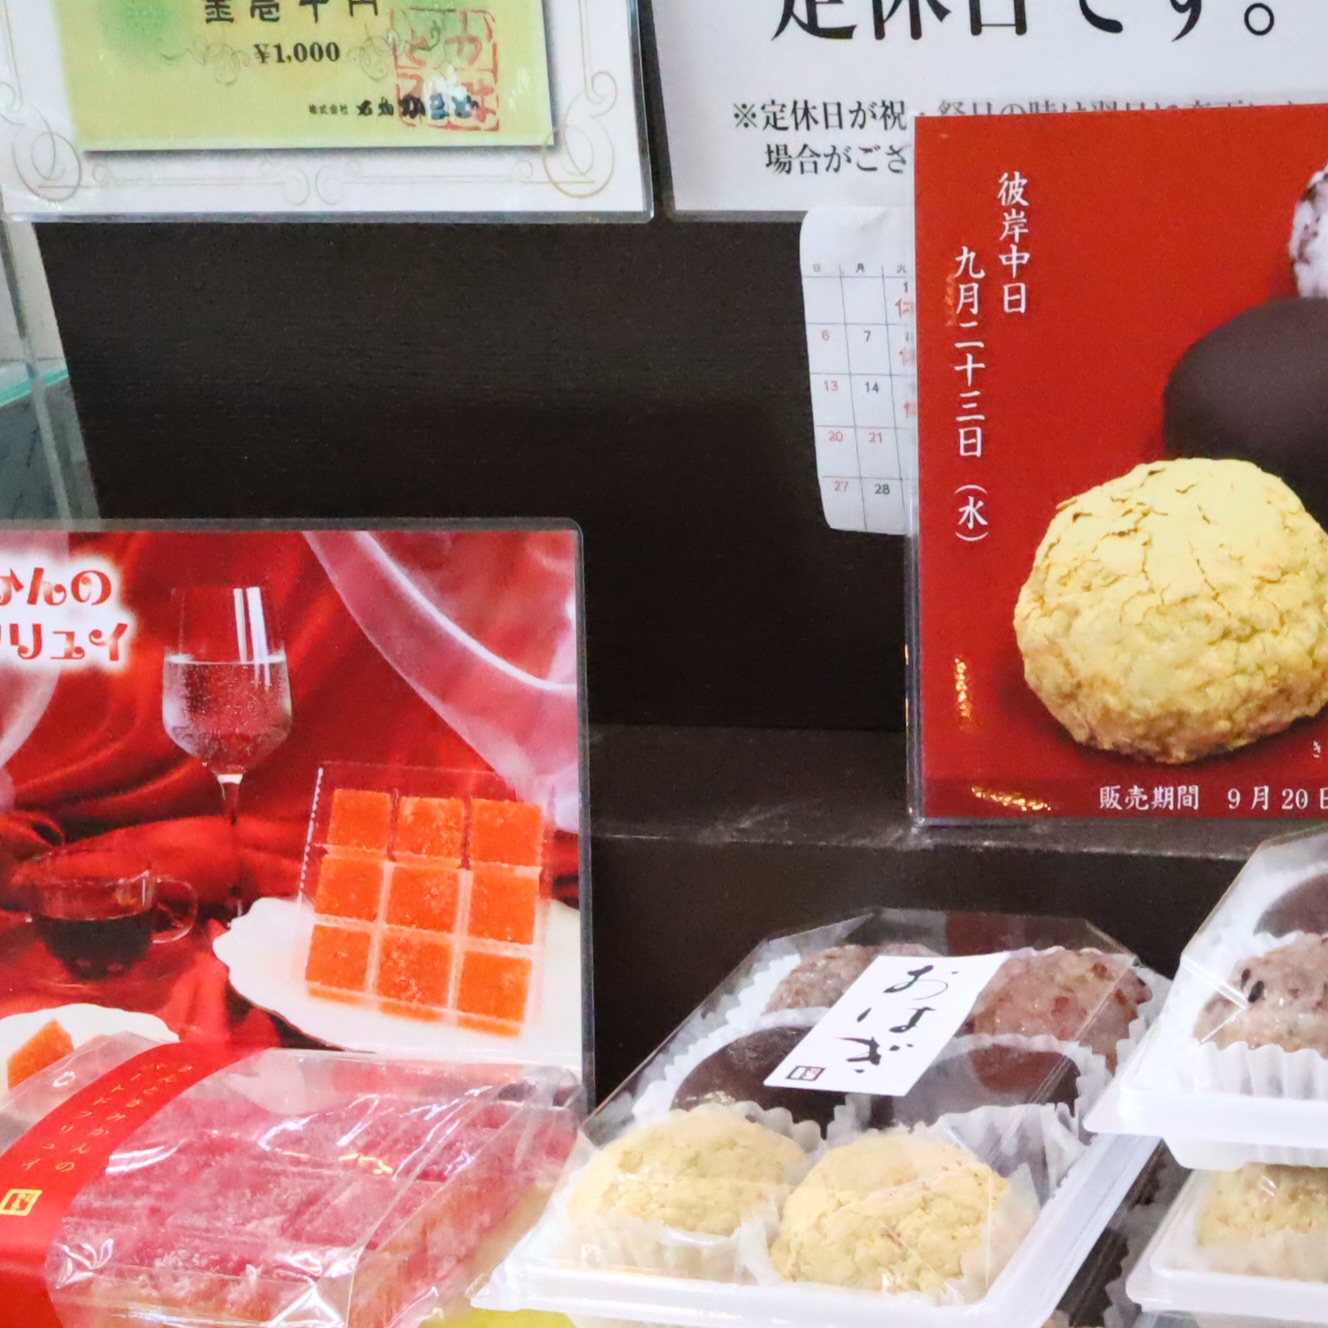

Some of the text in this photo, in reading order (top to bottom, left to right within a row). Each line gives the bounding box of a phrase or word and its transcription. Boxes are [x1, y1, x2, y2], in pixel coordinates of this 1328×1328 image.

[253, 42, 341, 64] ¥1,000
[997, 170, 1031, 315] 彼岸中日
[863, 330, 872, 342] 7
[824, 380, 880, 394] 13 14
[828, 431, 883, 444] 20 21
[834, 481, 891, 496] 27 28
[1099, 785, 1199, 811] 販売期間
[836, 964, 959, 1074] おはぎ
